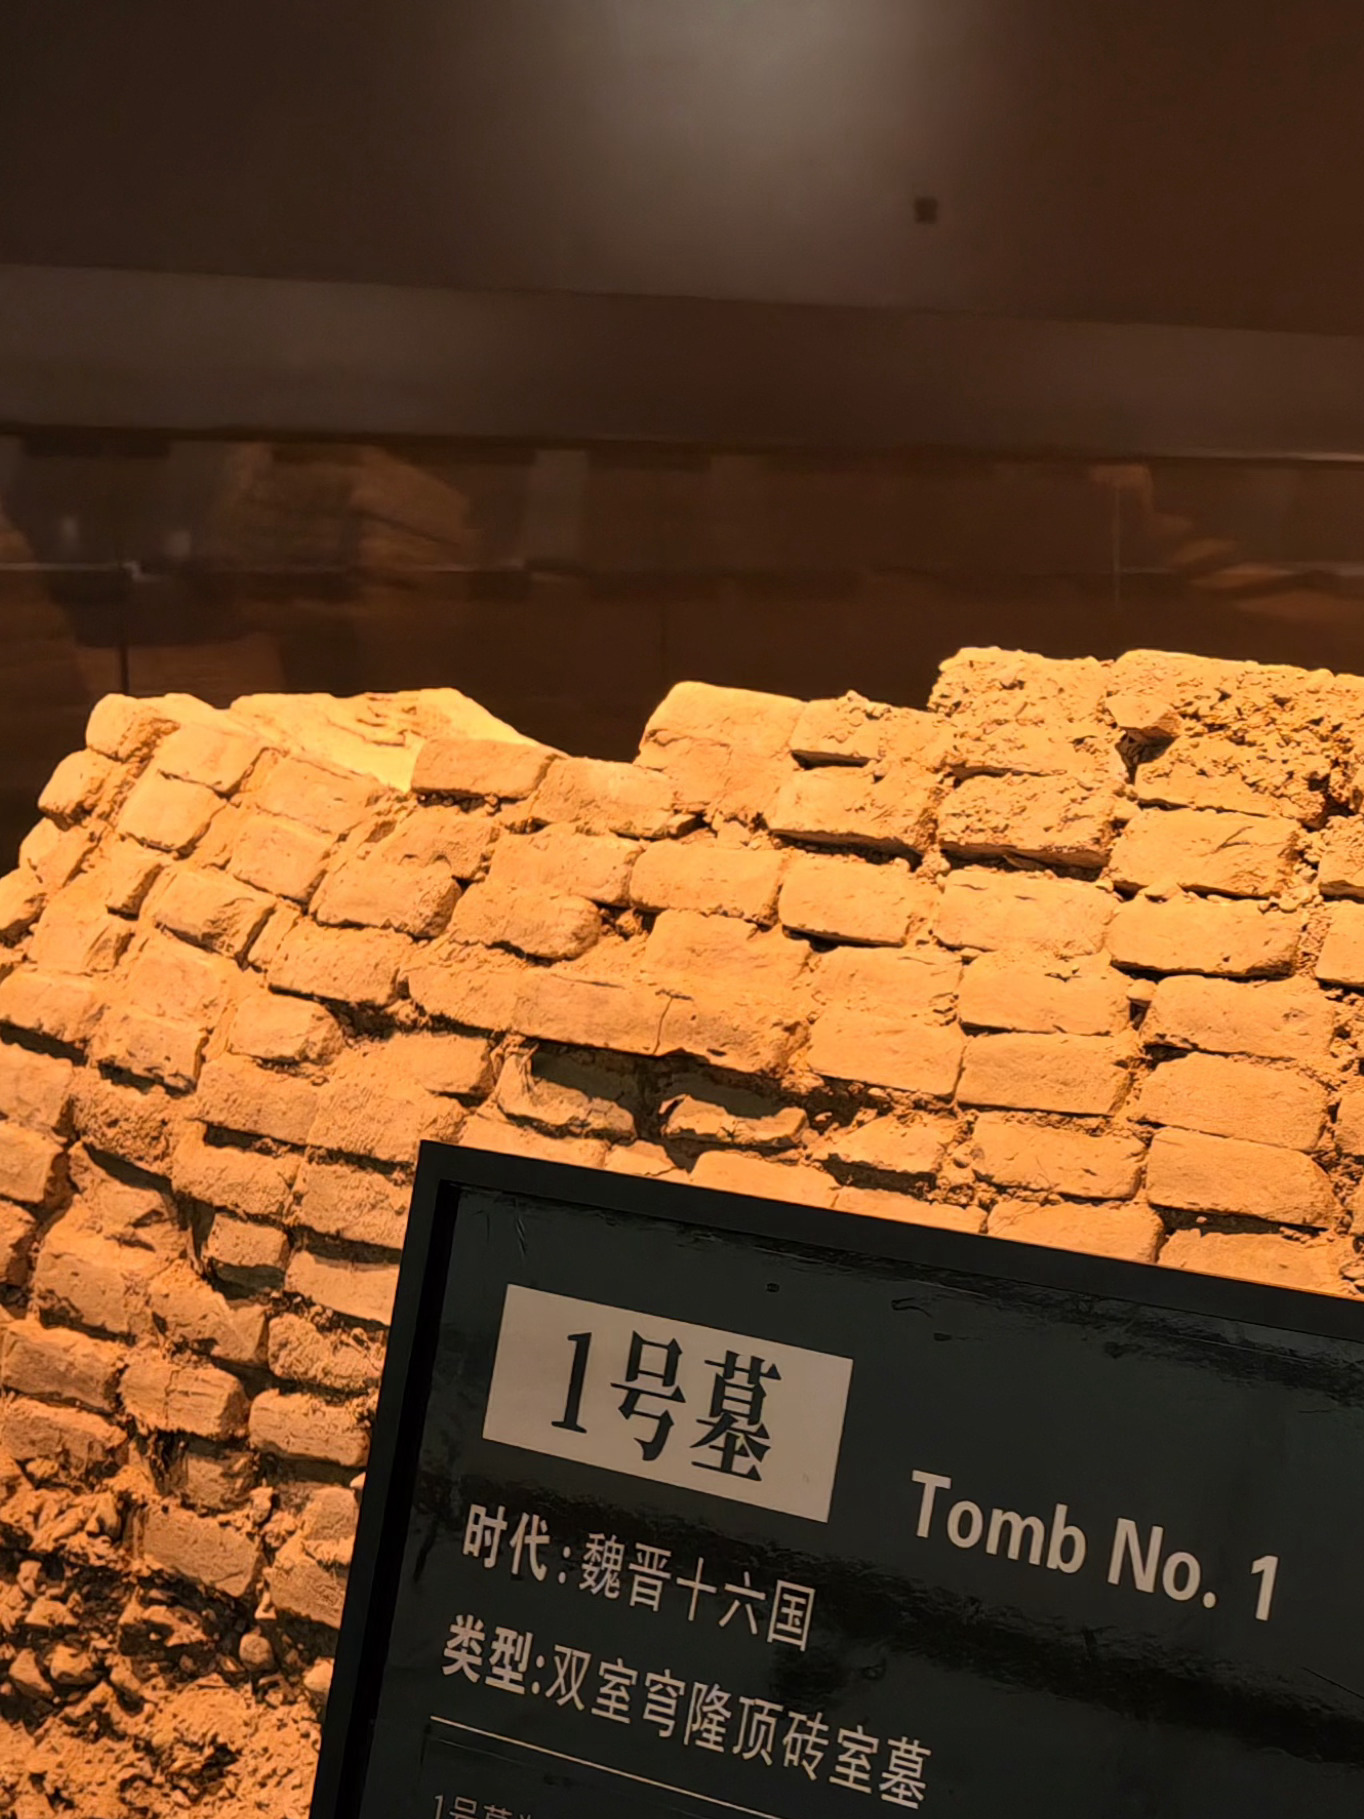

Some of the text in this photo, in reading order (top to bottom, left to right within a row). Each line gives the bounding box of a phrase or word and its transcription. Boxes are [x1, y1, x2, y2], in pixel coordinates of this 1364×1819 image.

[550, 1328, 782, 1484] 1号墓
[911, 1469, 1279, 1622] Tomb No. 1
